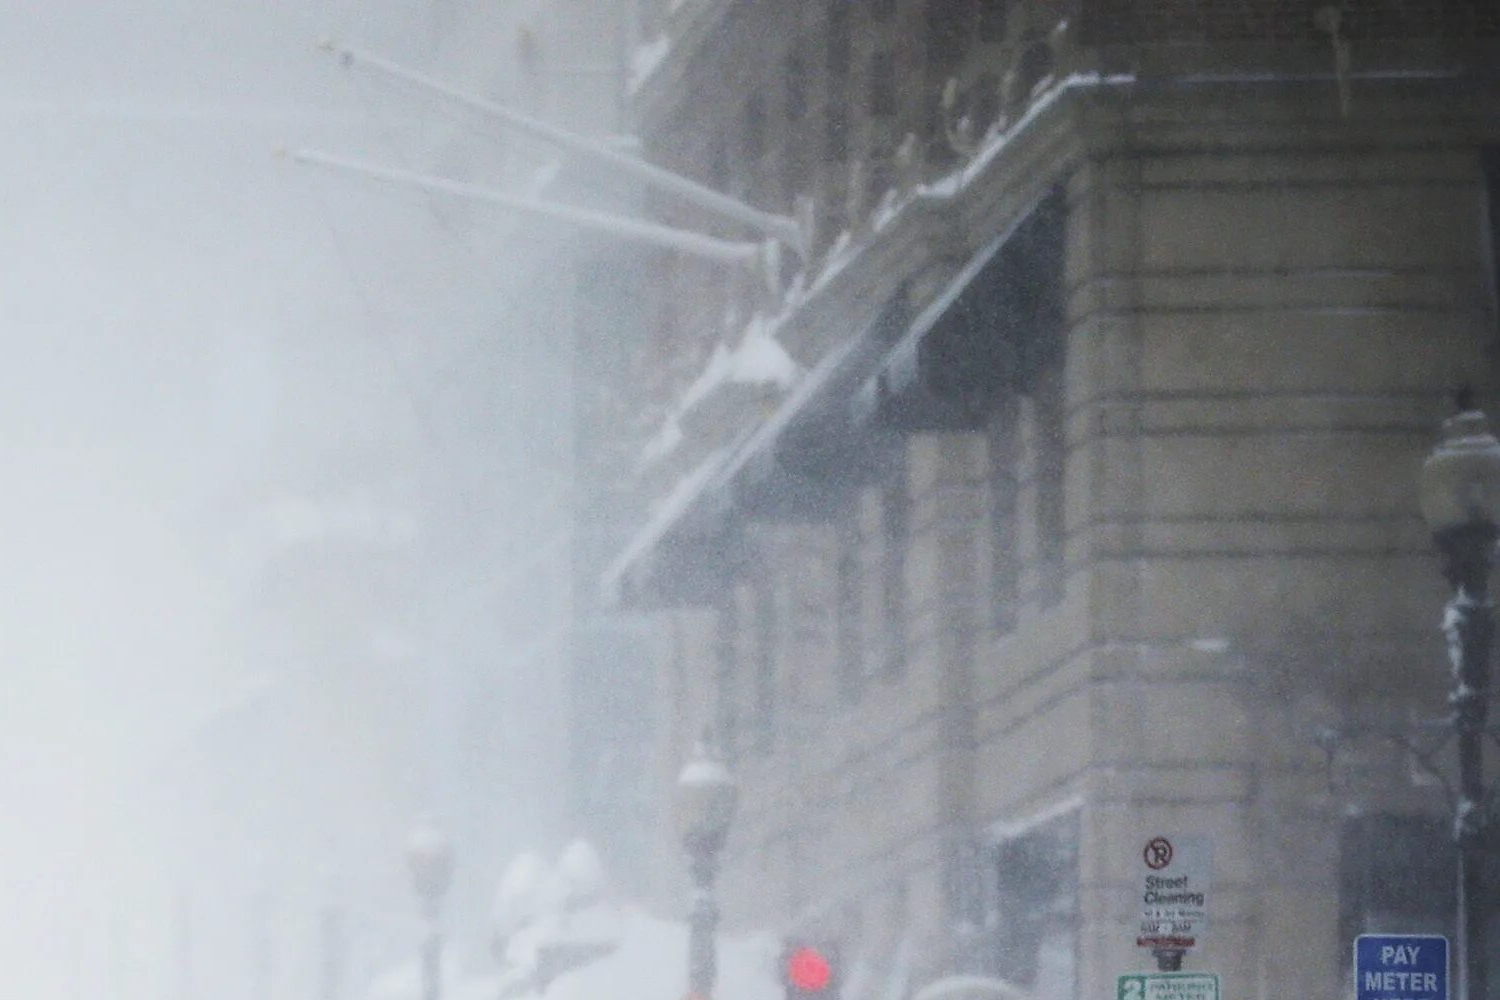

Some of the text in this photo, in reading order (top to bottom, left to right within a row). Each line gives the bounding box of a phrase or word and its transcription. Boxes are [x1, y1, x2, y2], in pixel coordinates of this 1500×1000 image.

[1146, 875, 1188, 889] Street
[1144, 891, 1204, 906] Cleaning
[1381, 945, 1420, 965] PAY
[1365, 971, 1437, 992] METER
